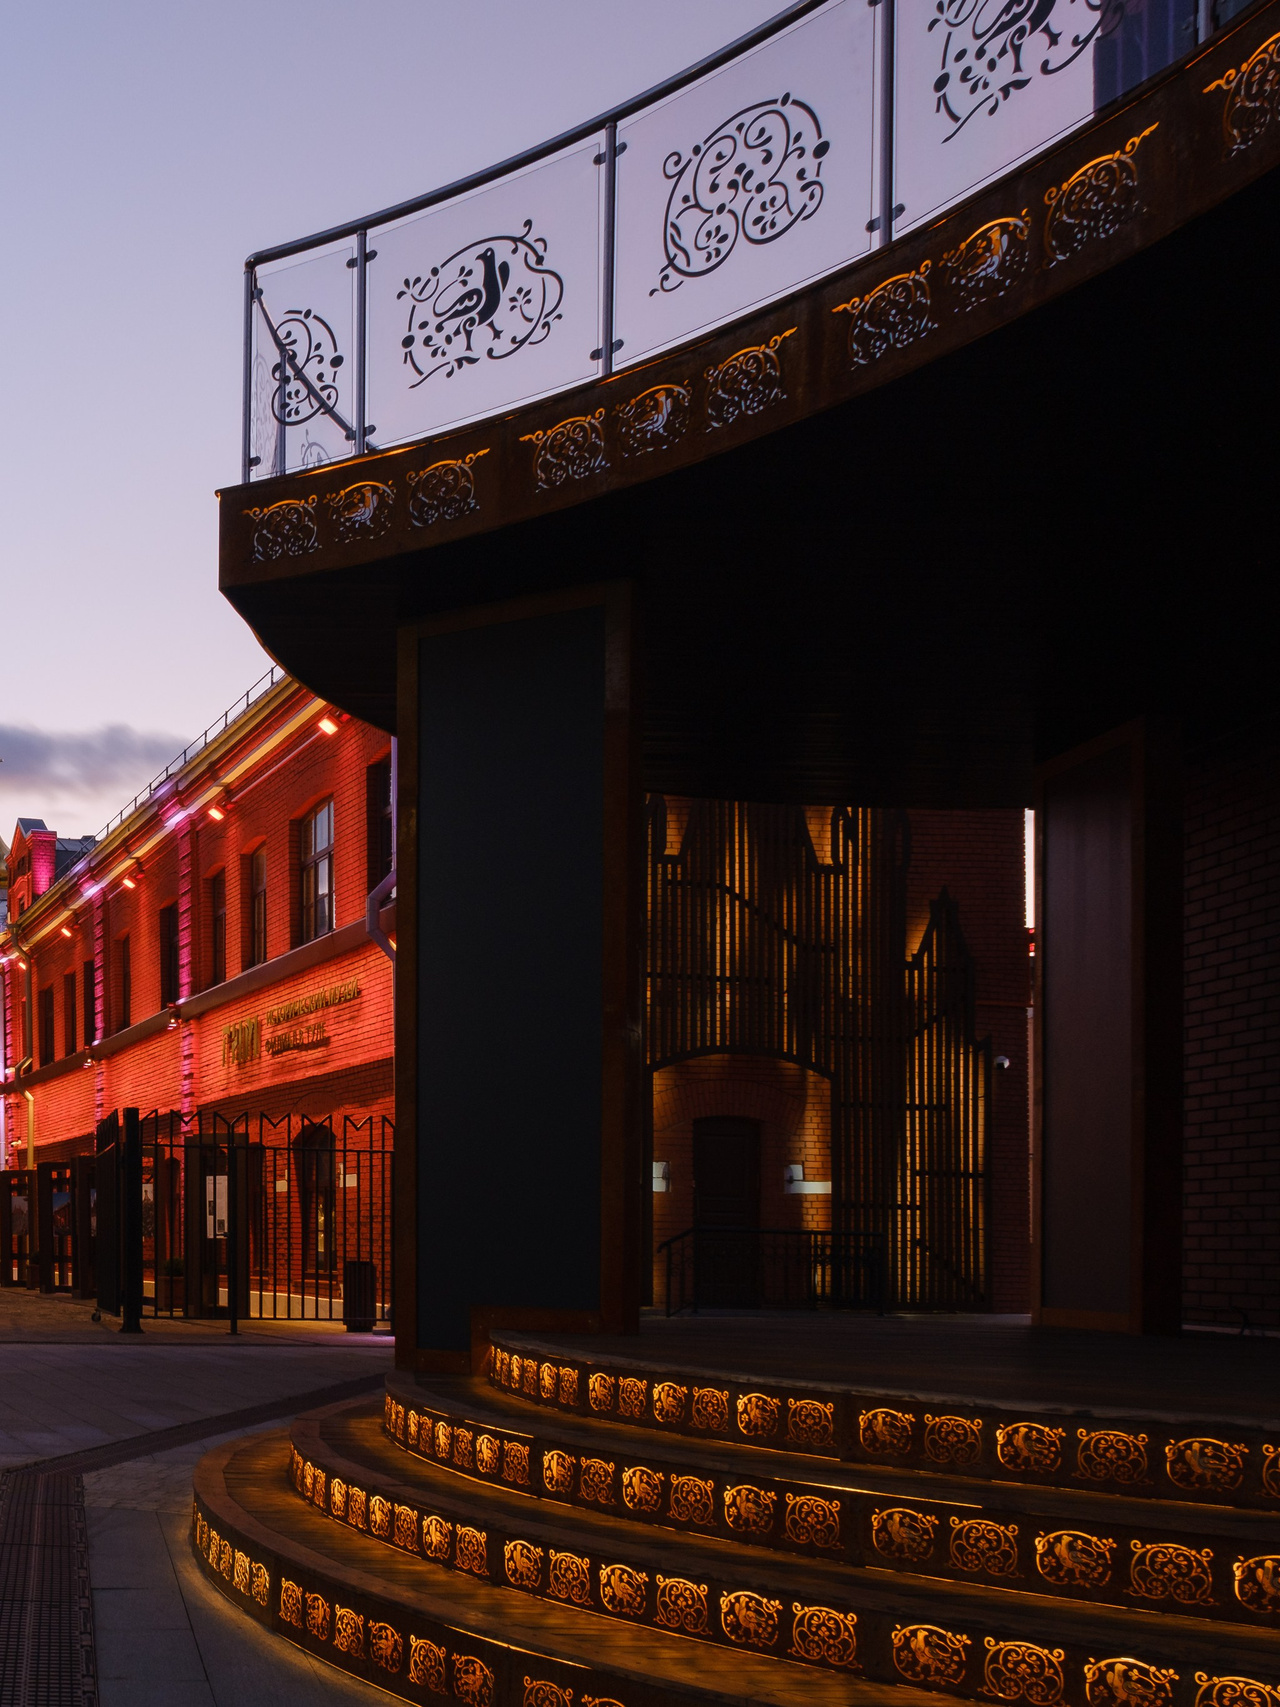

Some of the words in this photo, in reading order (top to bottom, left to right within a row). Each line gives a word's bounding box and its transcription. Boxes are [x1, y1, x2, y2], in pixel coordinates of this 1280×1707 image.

[266, 987, 326, 1026] ИСТОРИЧЕСКИЙ
[327, 977, 359, 1006] МУЗЕЙ
[222, 1014, 259, 1068] ГИМ
